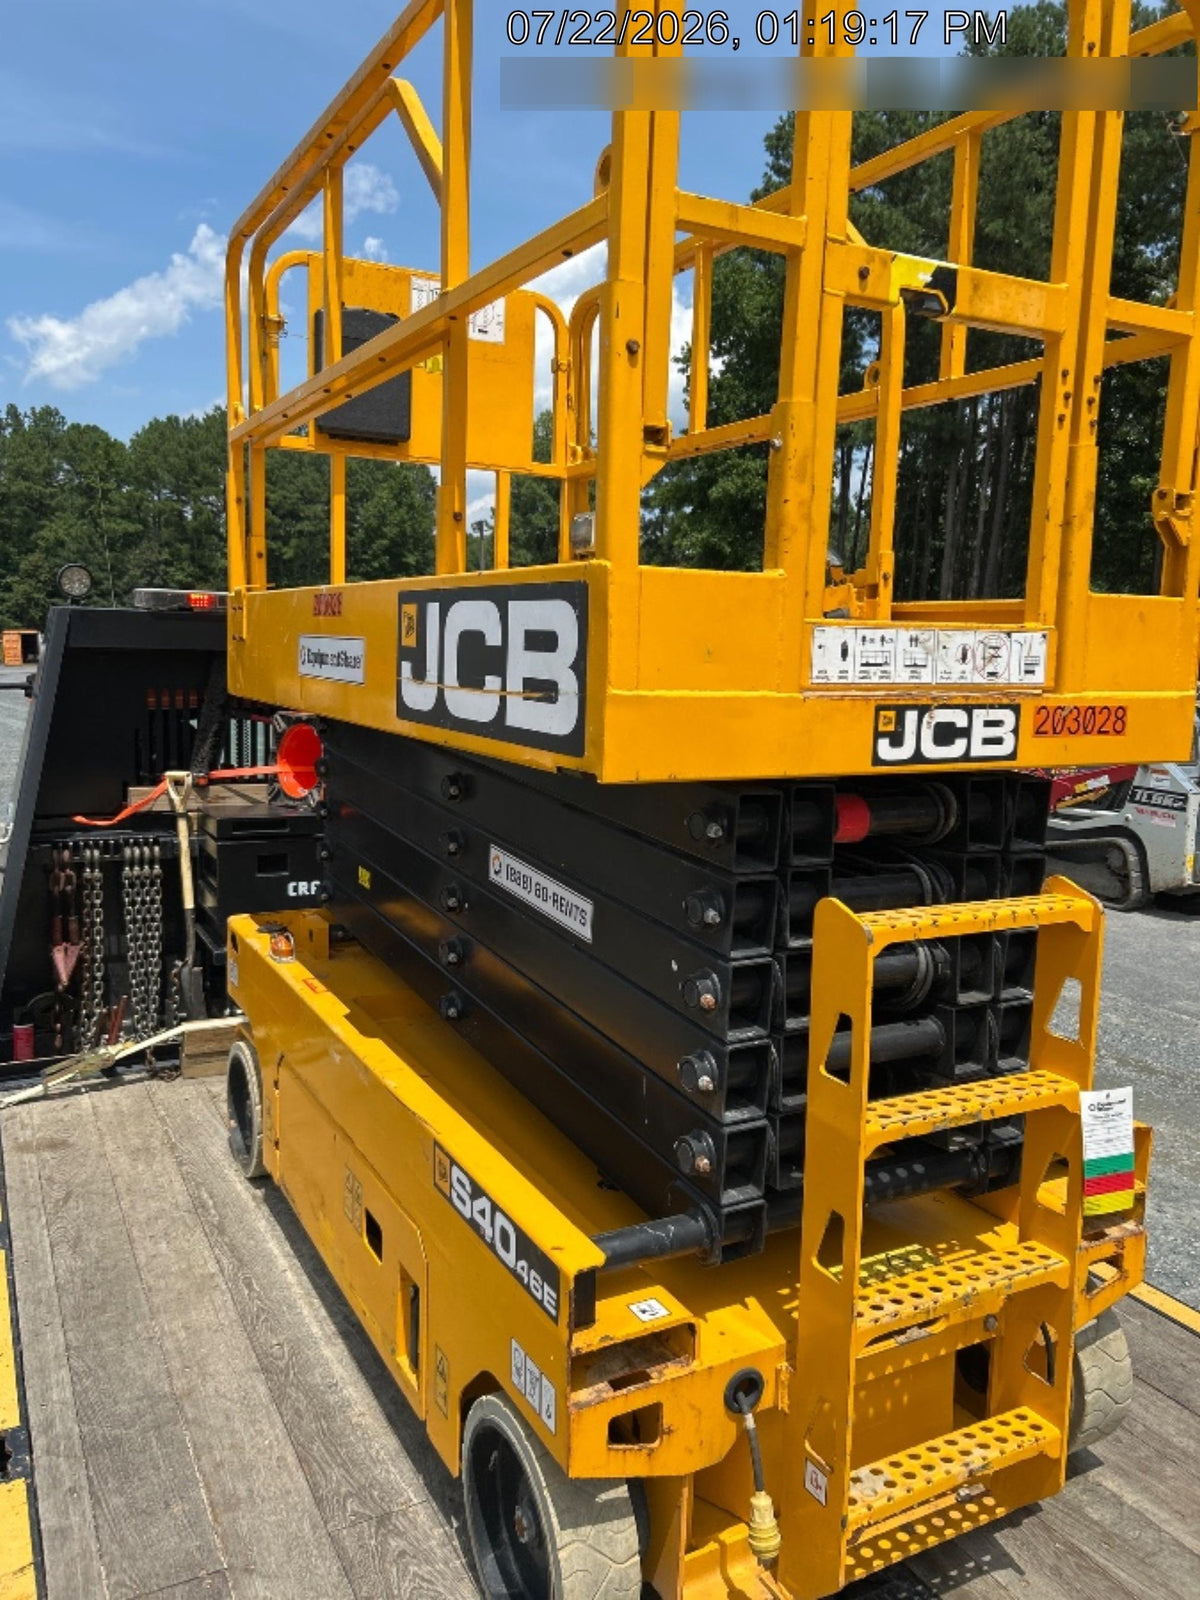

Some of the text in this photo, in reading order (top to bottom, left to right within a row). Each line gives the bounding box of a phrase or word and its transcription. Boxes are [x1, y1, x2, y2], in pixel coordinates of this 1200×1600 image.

[401, 599, 579, 737] JCB
[877, 708, 1017, 761] JCB
[1034, 705, 1128, 736] 203028
